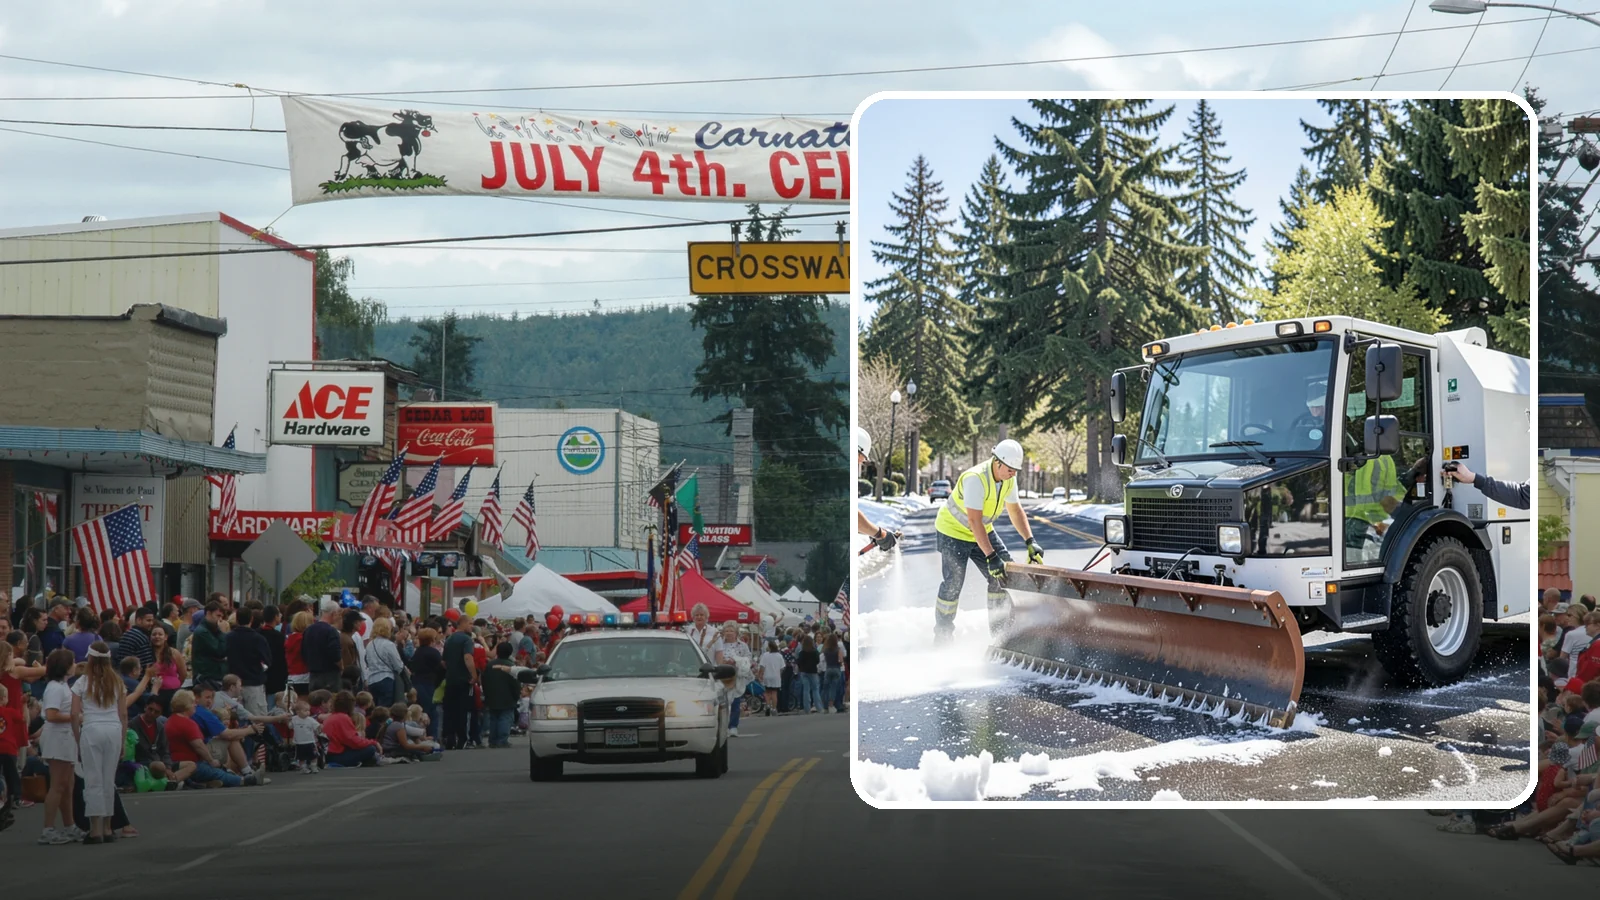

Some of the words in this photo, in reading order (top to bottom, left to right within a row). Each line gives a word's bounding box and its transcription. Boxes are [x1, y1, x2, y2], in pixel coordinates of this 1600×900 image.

[481, 141, 605, 193] JULY
[632, 150, 747, 199] 4th.
[697, 254, 850, 280] CROSSWA
[282, 380, 374, 420] ACE
[406, 409, 452, 422] CEDAR
[283, 421, 371, 437] Hardware
[416, 427, 477, 447] Coca-Cola
[82, 485, 94, 495] St.
[95, 485, 124, 495] Vincent
[126, 486, 135, 495] de
[137, 486, 155, 495] Paul
[688, 526, 741, 535] CRNATION
[699, 535, 730, 543] GLASS
